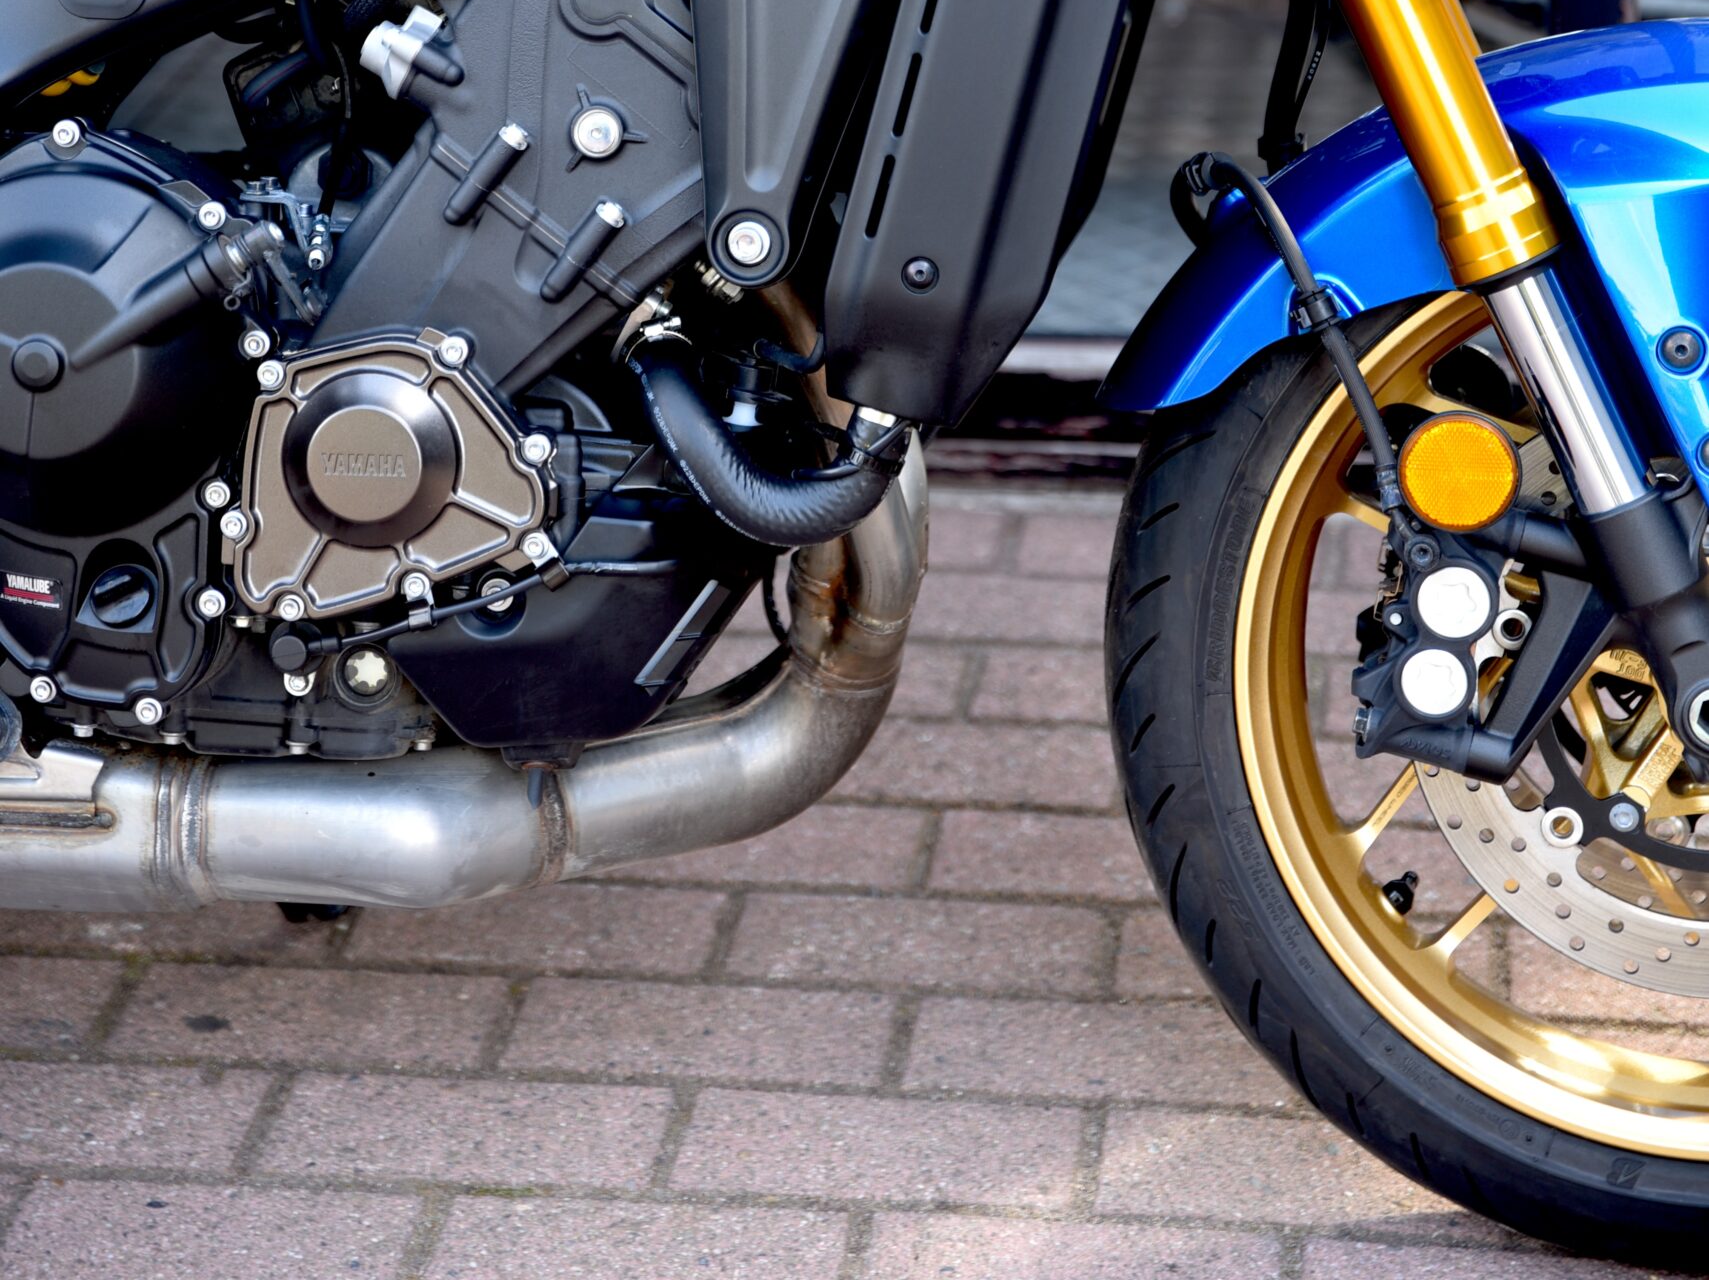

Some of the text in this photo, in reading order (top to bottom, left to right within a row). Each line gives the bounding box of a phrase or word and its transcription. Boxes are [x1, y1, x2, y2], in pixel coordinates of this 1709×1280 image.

[320, 452, 406, 478] YAMAHA
[6, 573, 51, 594] YAMALUBE
[1203, 498, 1256, 683] BRIDGESTONE
